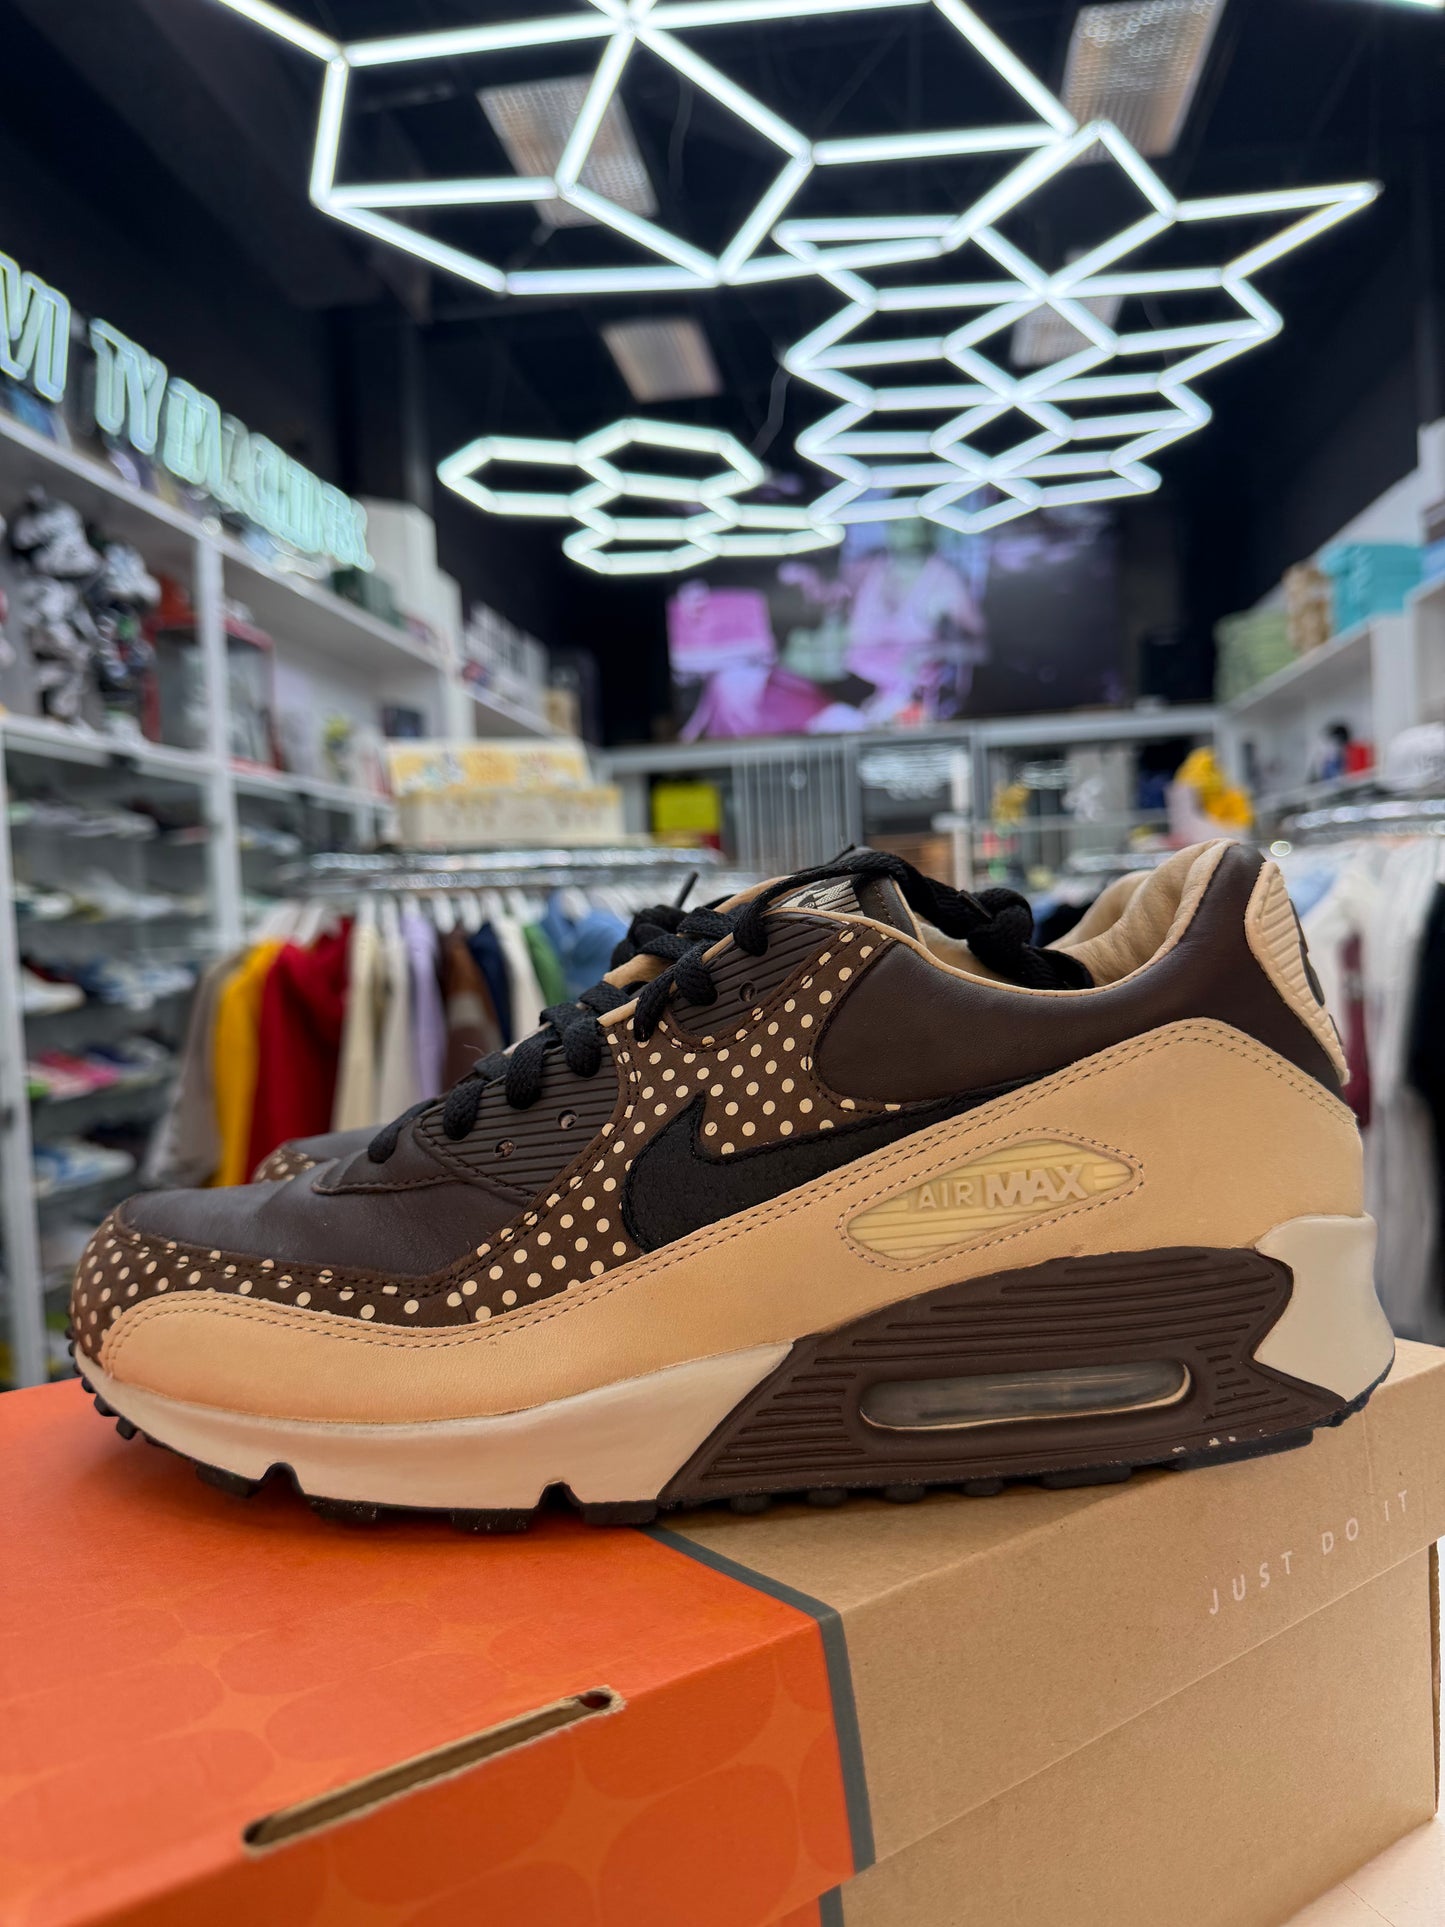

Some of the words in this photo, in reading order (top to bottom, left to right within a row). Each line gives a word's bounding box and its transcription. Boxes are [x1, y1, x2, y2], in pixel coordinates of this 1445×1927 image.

[917, 1180, 976, 1210] AIR
[982, 1162, 1089, 1210] MAX
[1209, 1550, 1293, 1616] JUST
[1321, 1517, 1359, 1556] DO
[1384, 1489, 1408, 1522] IT
